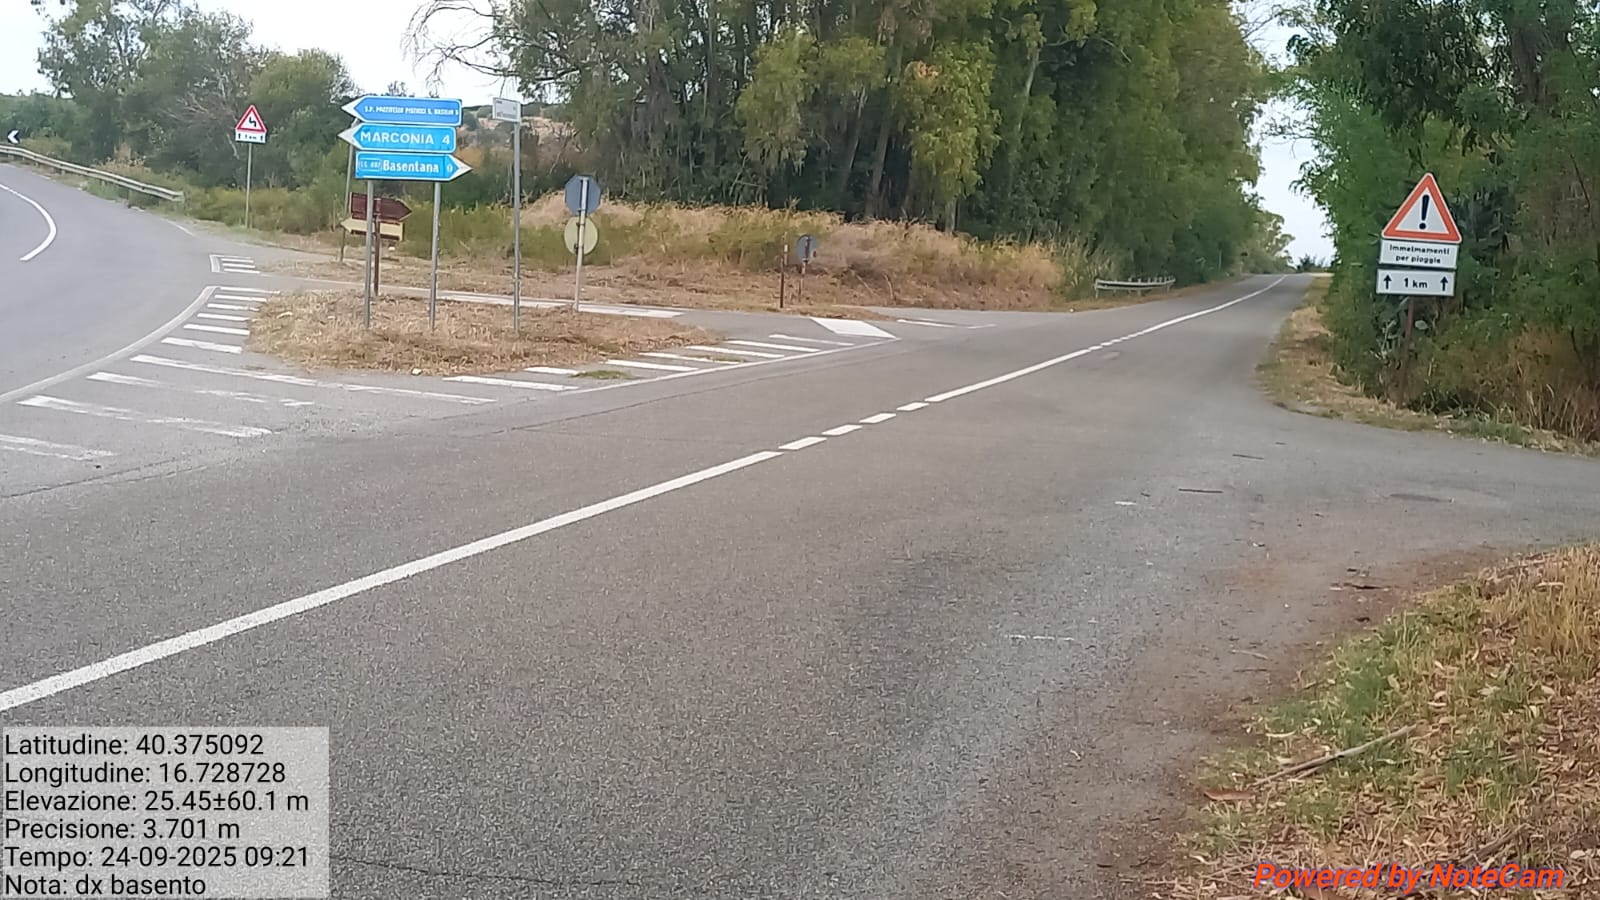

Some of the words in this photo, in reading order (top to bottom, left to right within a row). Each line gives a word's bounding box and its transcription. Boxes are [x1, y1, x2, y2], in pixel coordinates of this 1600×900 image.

[360, 131, 434, 145] MARCONIA
[442, 134, 450, 145] 4
[382, 160, 439, 173] Basentana
[1404, 277, 1409, 288] 1
[1412, 280, 1428, 288] km
